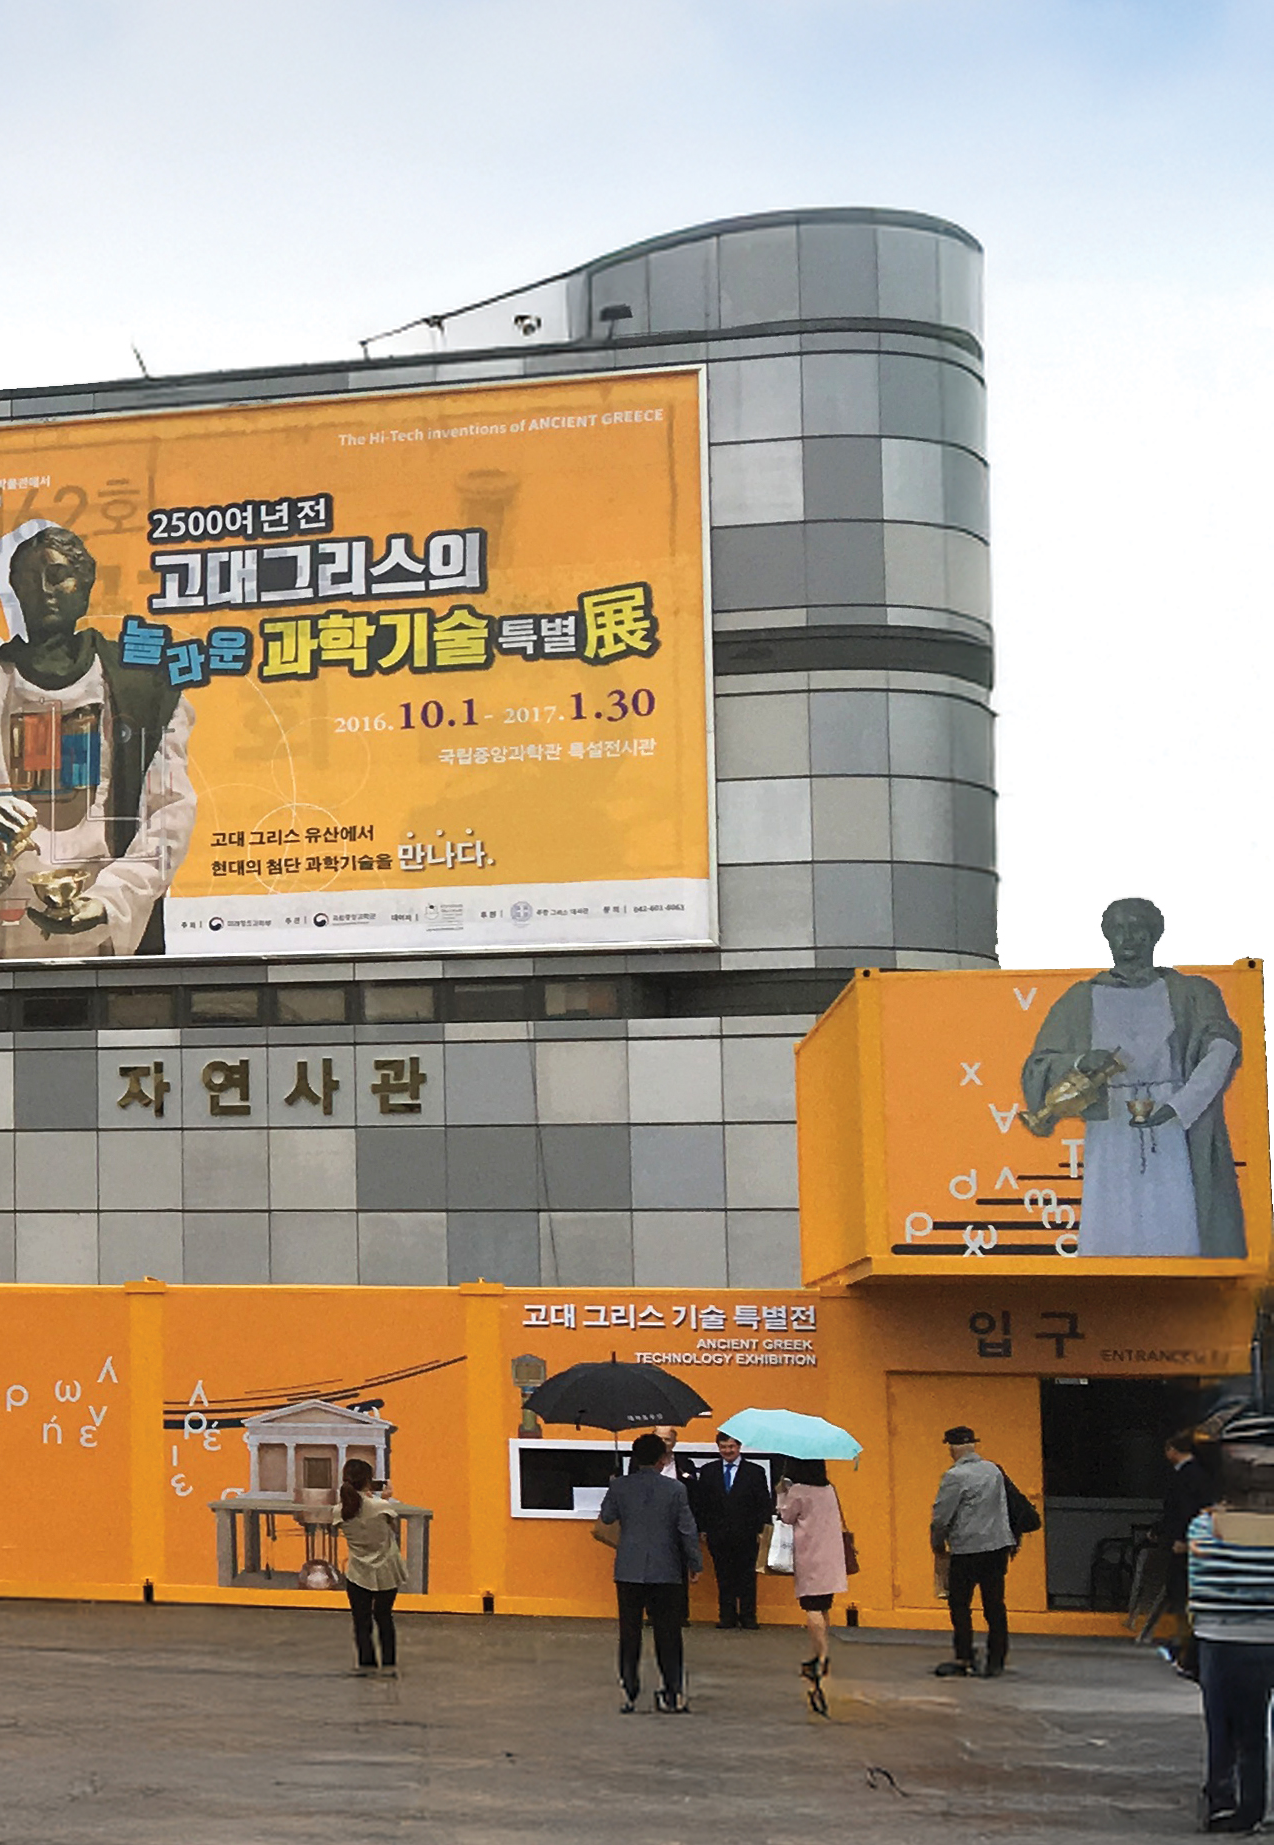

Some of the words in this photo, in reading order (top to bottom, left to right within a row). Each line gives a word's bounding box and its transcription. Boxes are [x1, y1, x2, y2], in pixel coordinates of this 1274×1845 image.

[339, 434, 366, 446] The
[369, 429, 423, 445] Hi-Tech
[428, 423, 506, 440] inventions
[510, 419, 526, 434] of
[528, 414, 597, 431] ANCIENT
[602, 409, 664, 425] GREECE
[153, 532, 481, 609] 고대그리스의
[122, 620, 248, 686] 놀라운
[439, 744, 562, 766] 국립중앙과학관
[211, 830, 245, 848] 고대
[249, 828, 301, 846] 그리스
[305, 825, 374, 844] 유산에서
[211, 859, 261, 876] 현대의
[266, 857, 301, 875] 첨단
[305, 853, 393, 873] 과학기술을
[117, 1056, 428, 1117] 자연사관
[522, 1303, 576, 1329] 고대
[583, 1304, 666, 1328] 그리스
[672, 1304, 726, 1330] 기술
[734, 1305, 817, 1331] 특별전
[696, 1338, 759, 1350] ANCIENT
[762, 1339, 813, 1351] GREEK
[969, 1310, 1085, 1358] 입구
[634, 1352, 732, 1365] TECHNOLOGY
[736, 1353, 817, 1366] EXHIBITION
